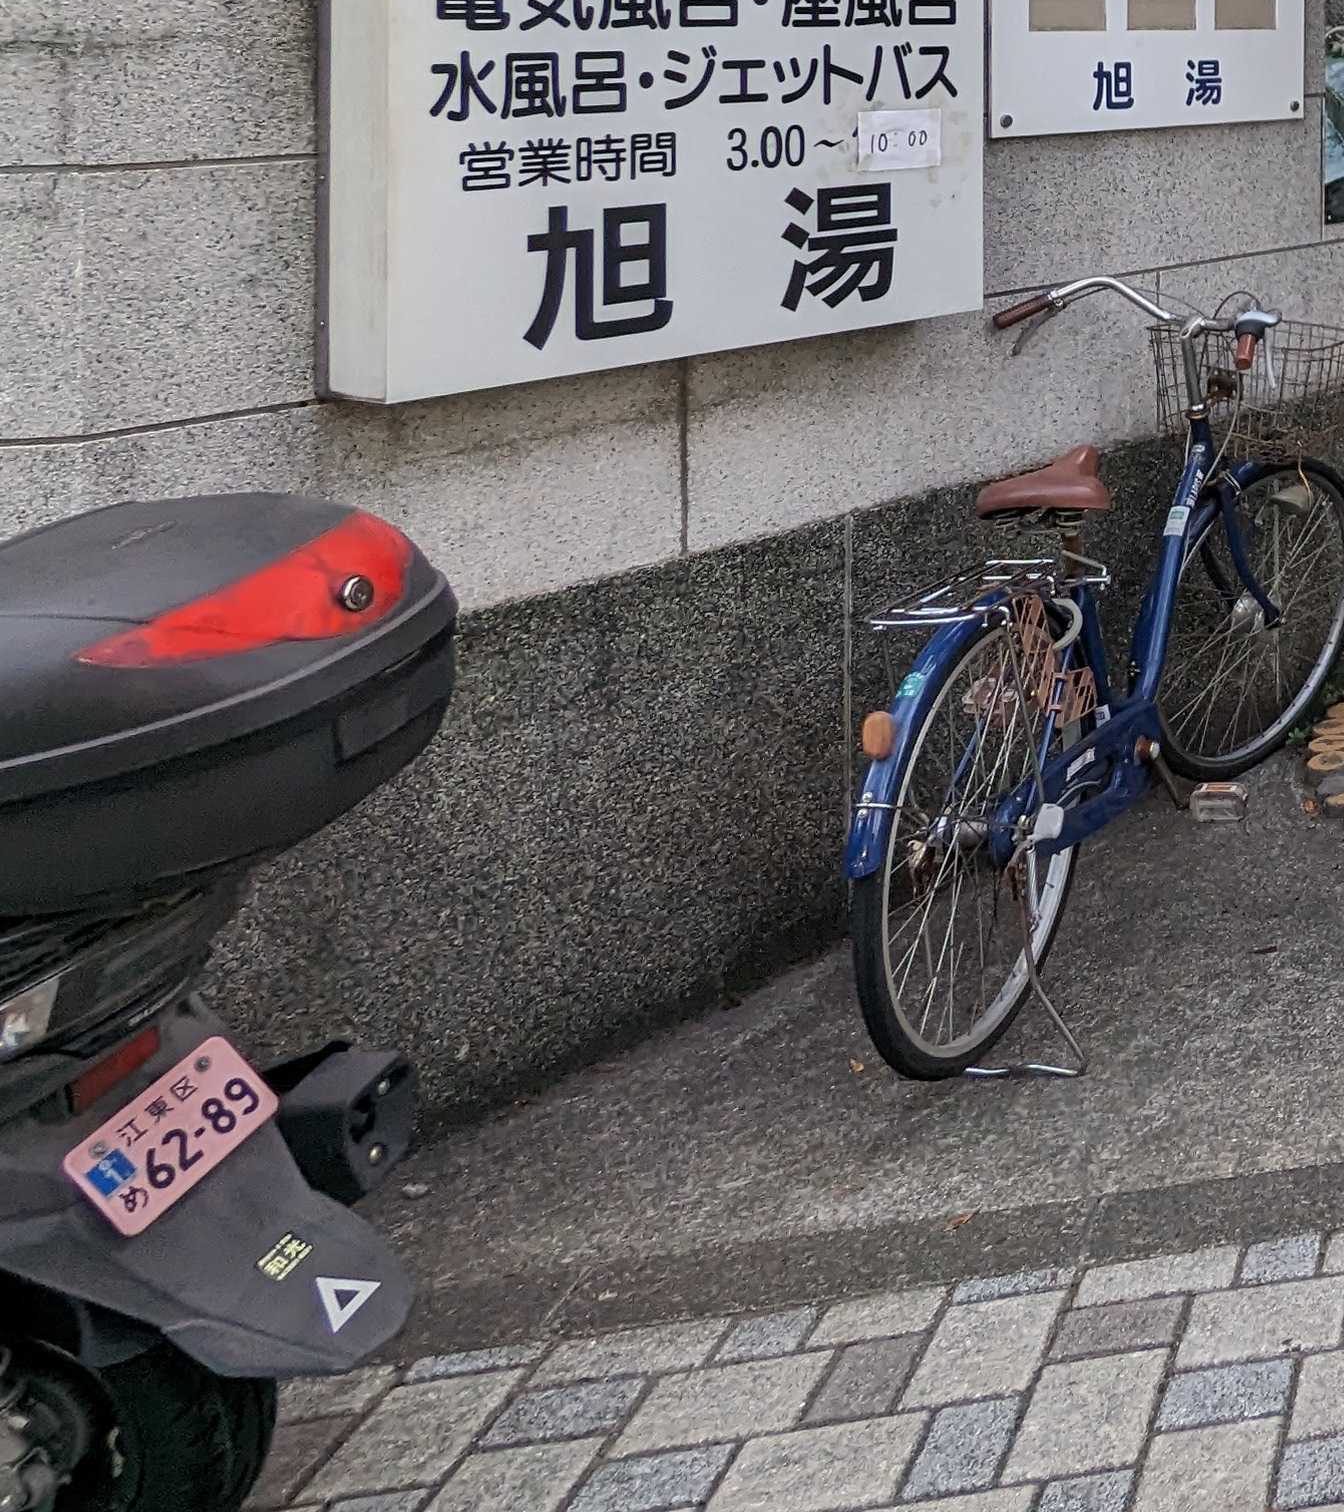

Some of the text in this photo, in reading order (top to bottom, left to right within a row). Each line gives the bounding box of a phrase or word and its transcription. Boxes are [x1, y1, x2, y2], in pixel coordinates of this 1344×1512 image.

[429, 44, 959, 122] 水風呂・ジェットバス
[1093, 59, 1223, 111] 旭湯
[459, 131, 677, 191] 営業時間
[523, 182, 899, 351] 旭湯
[116, 1075, 199, 1147] 江東区
[146, 1078, 260, 1189] 62-89
